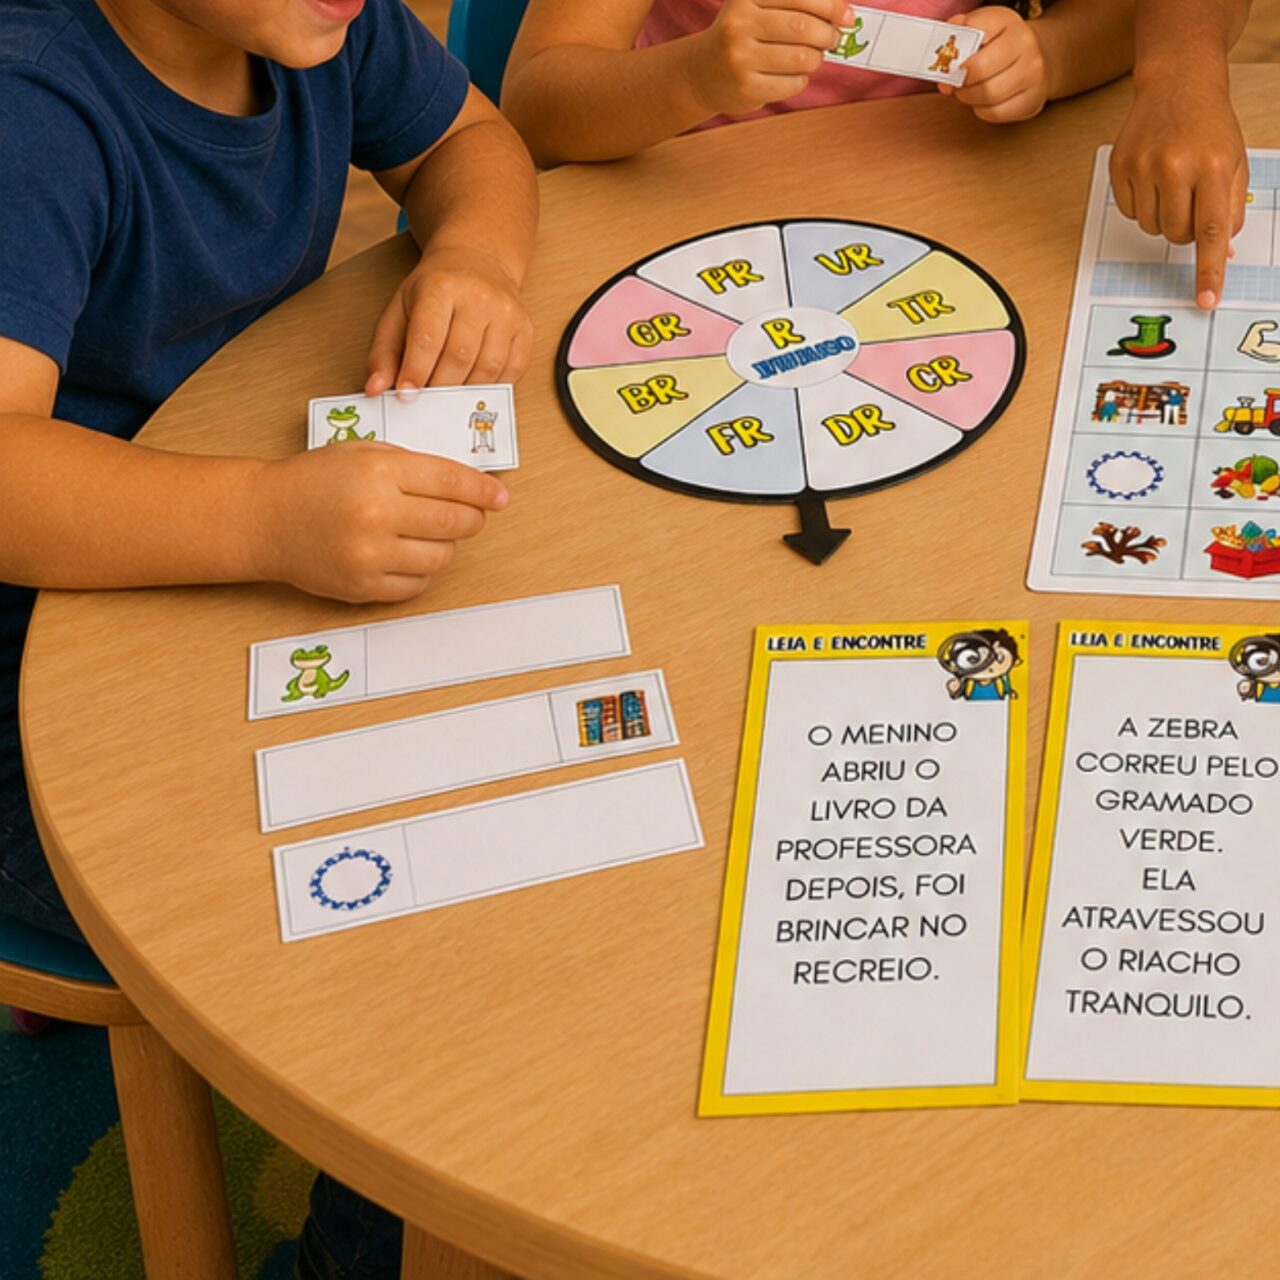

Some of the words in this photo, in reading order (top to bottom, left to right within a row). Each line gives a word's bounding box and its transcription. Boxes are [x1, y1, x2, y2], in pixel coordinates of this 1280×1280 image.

[815, 242, 884, 276] VR
[697, 259, 765, 295] PR
[887, 289, 956, 325] TR
[761, 317, 806, 350] R
[906, 354, 973, 393] CR
[617, 374, 688, 415] BR
[705, 415, 775, 456] FR
[821, 403, 895, 447] DR
[766, 635, 806, 652] LEIA
[812, 635, 823, 650] E
[830, 633, 928, 650] ENCONTRE
[1070, 632, 1108, 648] LEIA
[1113, 634, 1124, 648] E
[1130, 634, 1222, 652] ENCONTRE
[807, 725, 833, 746] O
[840, 721, 958, 746] MENINO
[1117, 717, 1138, 737] A
[1147, 717, 1239, 740] ZEBRA
[820, 759, 906, 783] ABRIU
[915, 758, 941, 780] O
[1075, 751, 1197, 776] CORREU
[1206, 755, 1279, 779] PELO
[810, 797, 897, 822] LIVRO
[906, 796, 948, 818] DA
[1095, 789, 1254, 815] GRAMADO
[775, 833, 977, 862] PROFESSORA
[1119, 828, 1223, 853] VERDE.
[785, 875, 905, 902] DEPOIS,
[915, 873, 965, 897] FOI
[1142, 867, 1196, 892] ELA
[776, 915, 910, 943] BRINCAR
[919, 913, 967, 938] NO
[1061, 906, 1265, 936] ATRAVESSOU
[793, 956, 939, 985] RECREIO.
[1080, 947, 1108, 971] O
[1118, 948, 1241, 977] RIACHO
[1065, 989, 1251, 1020] TRANQUILO.
